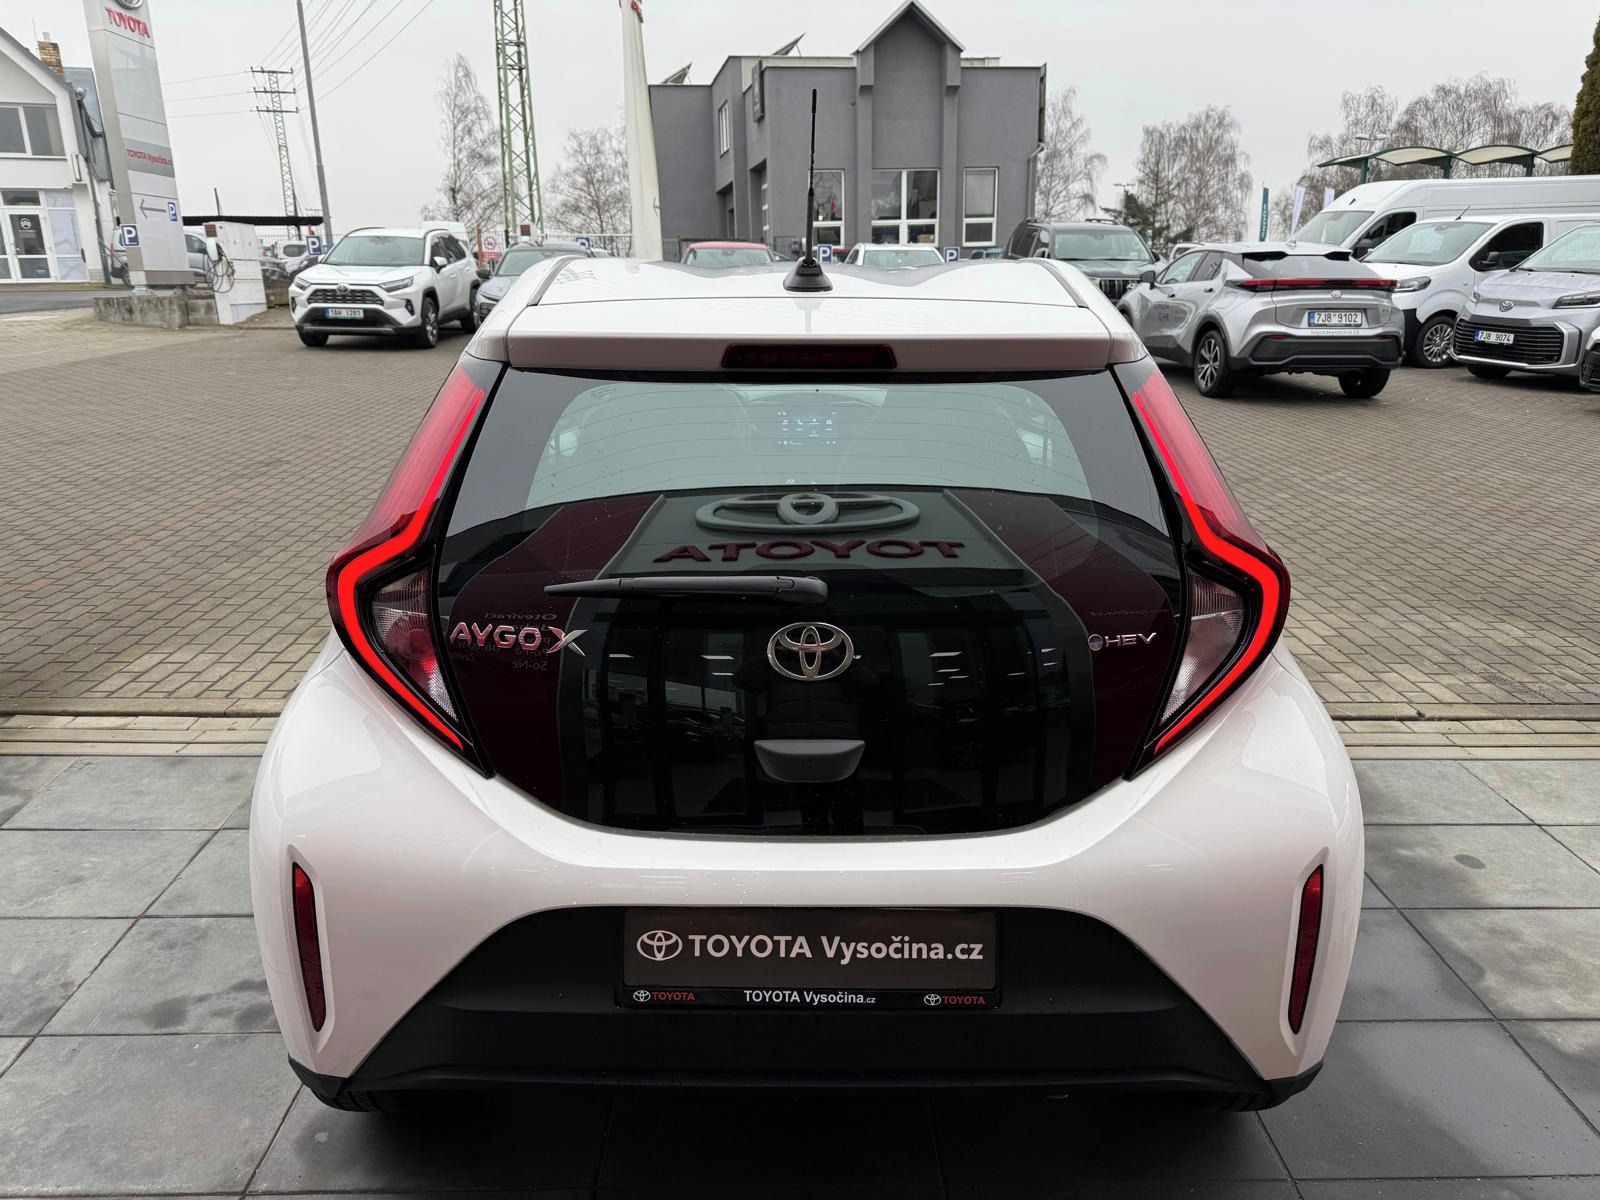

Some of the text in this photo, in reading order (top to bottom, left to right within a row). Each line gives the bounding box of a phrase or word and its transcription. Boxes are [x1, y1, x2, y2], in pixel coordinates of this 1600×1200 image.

[105, 7, 150, 38] TOYOTA
[127, 149, 147, 160] TOYOTA
[169, 203, 176, 220] P
[123, 226, 136, 245] P
[308, 237, 319, 254] P
[820, 248, 830, 262] P
[946, 250, 957, 262] P
[1316, 313, 1358, 323] 7J8 9102
[1480, 331, 1511, 342] 7J8 9074
[450, 621, 542, 651] AYGO
[1104, 632, 1157, 648] HEV
[688, 934, 984, 965] TOYOTA Vysočina.cz
[652, 991, 695, 1001] TOYOTA
[744, 990, 876, 1006] TOYOTA Vysočina.cz
[943, 995, 986, 1005] TOYOTA
